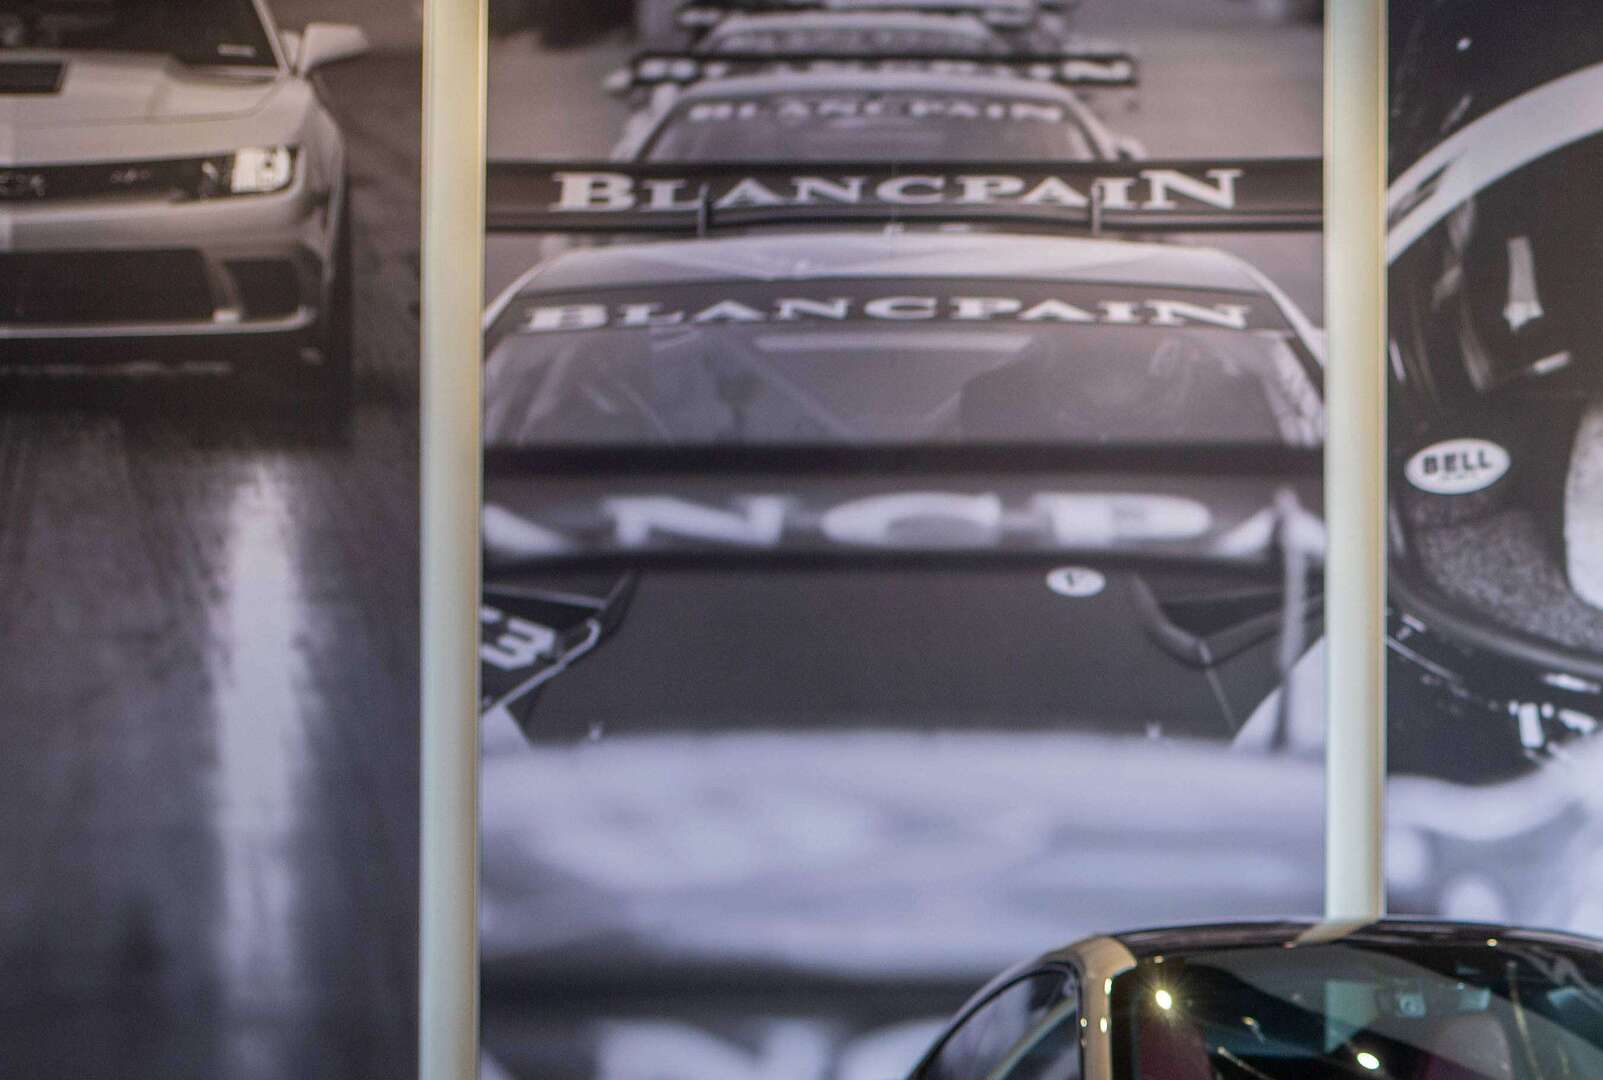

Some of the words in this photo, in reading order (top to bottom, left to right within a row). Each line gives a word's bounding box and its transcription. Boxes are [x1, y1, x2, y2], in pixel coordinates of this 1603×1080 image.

[548, 168, 1246, 215] BLANCPAIN
[523, 296, 1253, 334] BLANCPAIN
[1423, 449, 1492, 475] BELL
